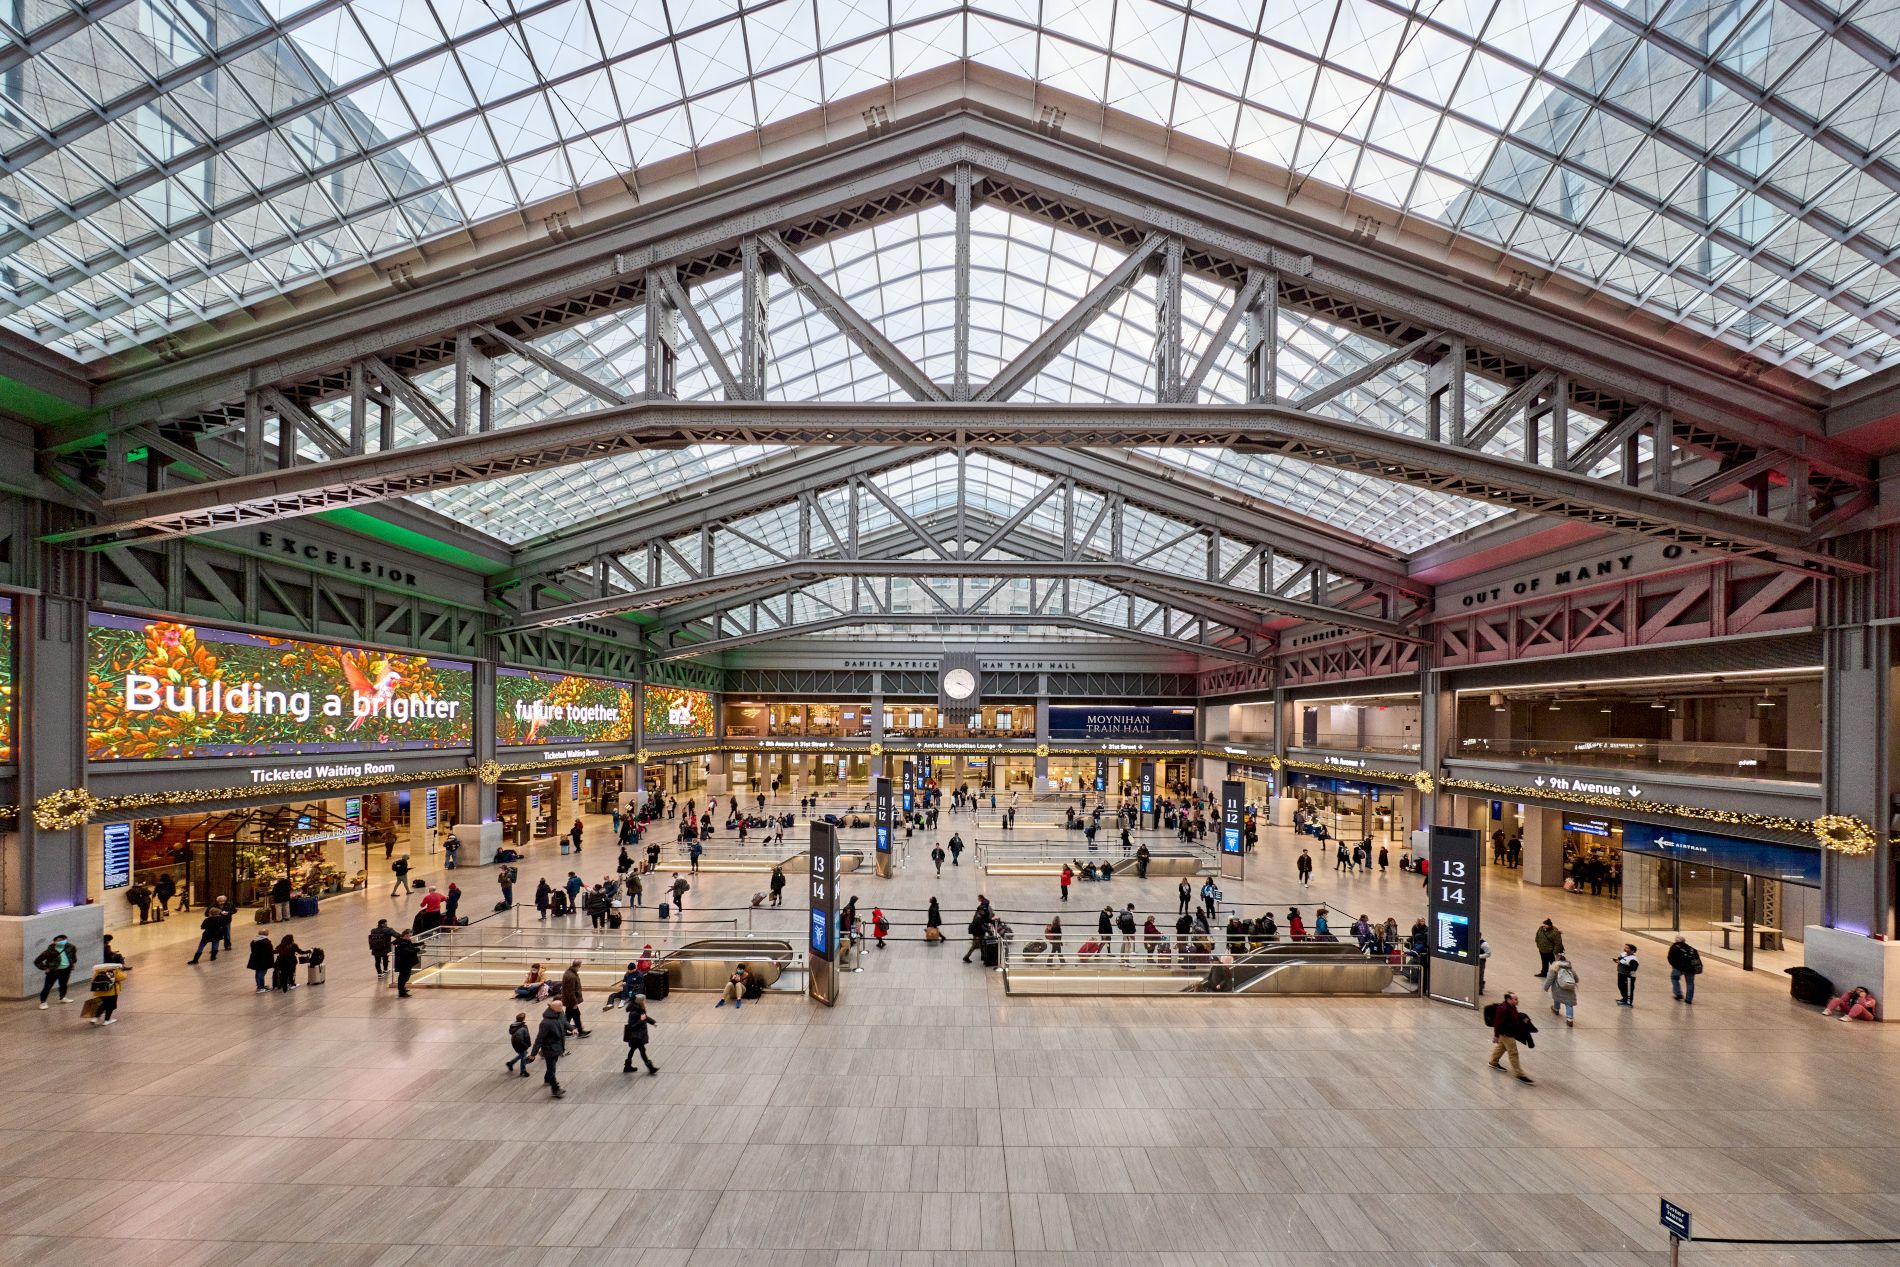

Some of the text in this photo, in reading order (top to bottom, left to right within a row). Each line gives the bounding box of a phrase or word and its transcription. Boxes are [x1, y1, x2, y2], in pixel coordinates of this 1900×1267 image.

[259, 531, 417, 586] EXCELSIOR
[1462, 588, 1501, 607] OUT
[1513, 578, 1540, 594] OF
[1555, 555, 1633, 585] MANY
[577, 621, 618, 638] UPWARD
[844, 660, 884, 668] DANIEL
[890, 660, 938, 669] PATRICK
[1050, 662, 1077, 670] HALL
[125, 673, 460, 724] Building a brighter
[515, 699, 620, 724] future together.
[1087, 715, 1150, 724] MOYNIHAN
[1086, 724, 1150, 733] TRAIN HALL
[944, 742, 975, 750] Metropolitan
[977, 743, 995, 751] Lounge
[543, 749, 599, 760] Ticketed Waiting Room
[250, 762, 395, 783] Ticketed Waiting Room
[1144, 774, 1149, 782] 9
[1143, 784, 1151, 792] 10
[1550, 777, 1621, 796] 9th Avenue
[879, 796, 886, 806] 11
[1227, 798, 1238, 809] 11
[878, 810, 886, 821] 12
[1226, 813, 1238, 824] 12
[1675, 842, 1708, 853] AIRTRAIN
[813, 855, 825, 873] 13
[1443, 860, 1465, 878] 13
[812, 881, 825, 900] 14
[1441, 886, 1466, 905] 14
[1666, 1204, 1684, 1217] Enter
[1667, 1210, 1683, 1222] here
